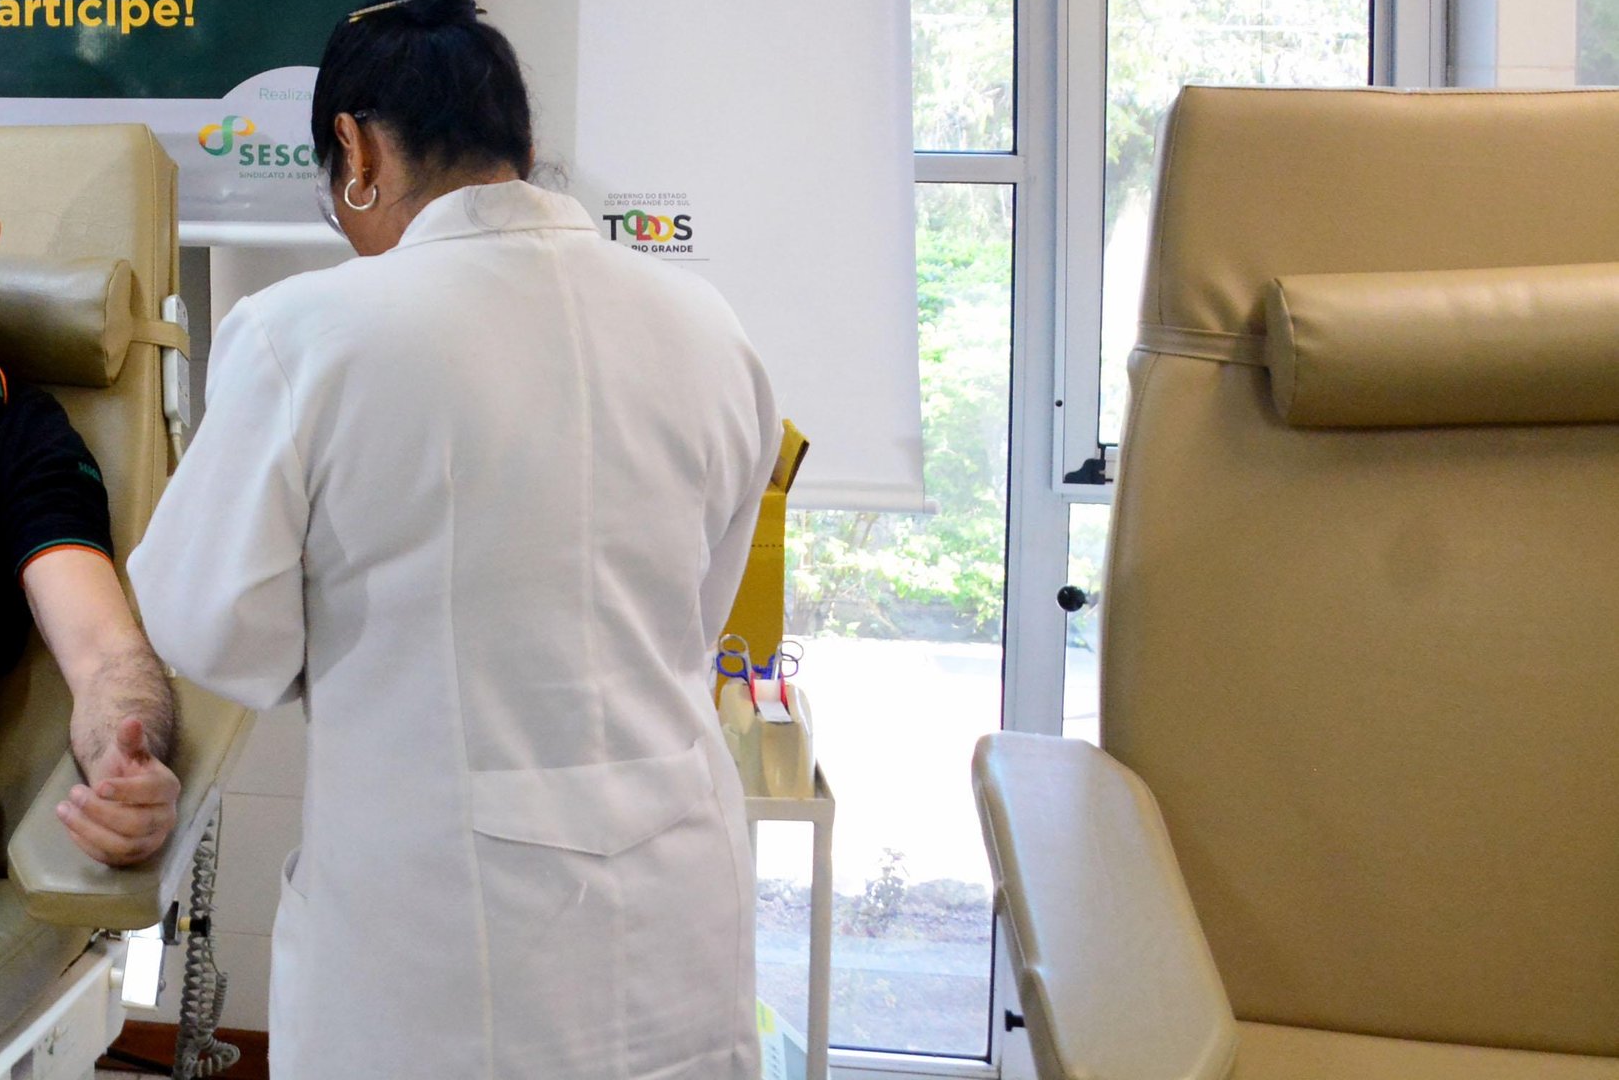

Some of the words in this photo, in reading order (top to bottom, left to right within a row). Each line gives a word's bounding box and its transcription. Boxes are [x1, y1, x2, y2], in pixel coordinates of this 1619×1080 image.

[239, 171, 285, 179] SINDICATO
[602, 209, 693, 243] TODOS
[651, 245, 693, 253] GRANDE
